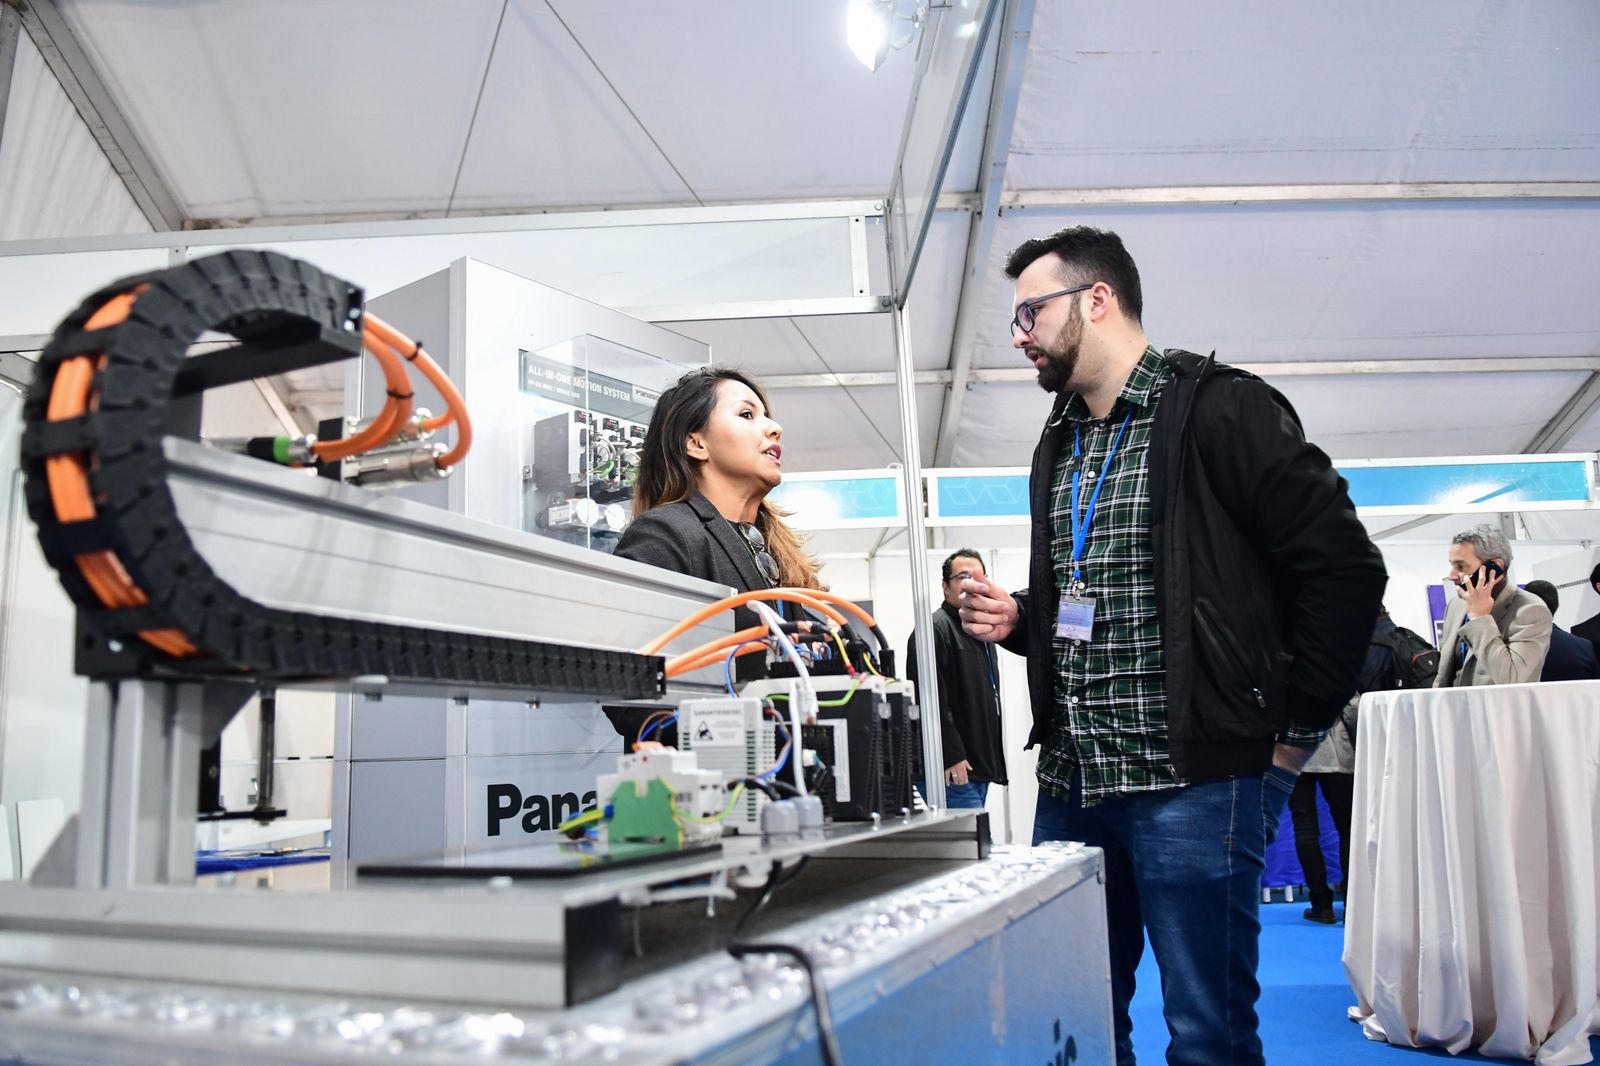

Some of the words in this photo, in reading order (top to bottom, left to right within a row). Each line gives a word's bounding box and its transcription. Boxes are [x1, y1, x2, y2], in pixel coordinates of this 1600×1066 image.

[528, 365, 571, 385] ALL-IN-ONE
[573, 376, 602, 393] MOTION
[603, 386, 630, 401] SYSTEM
